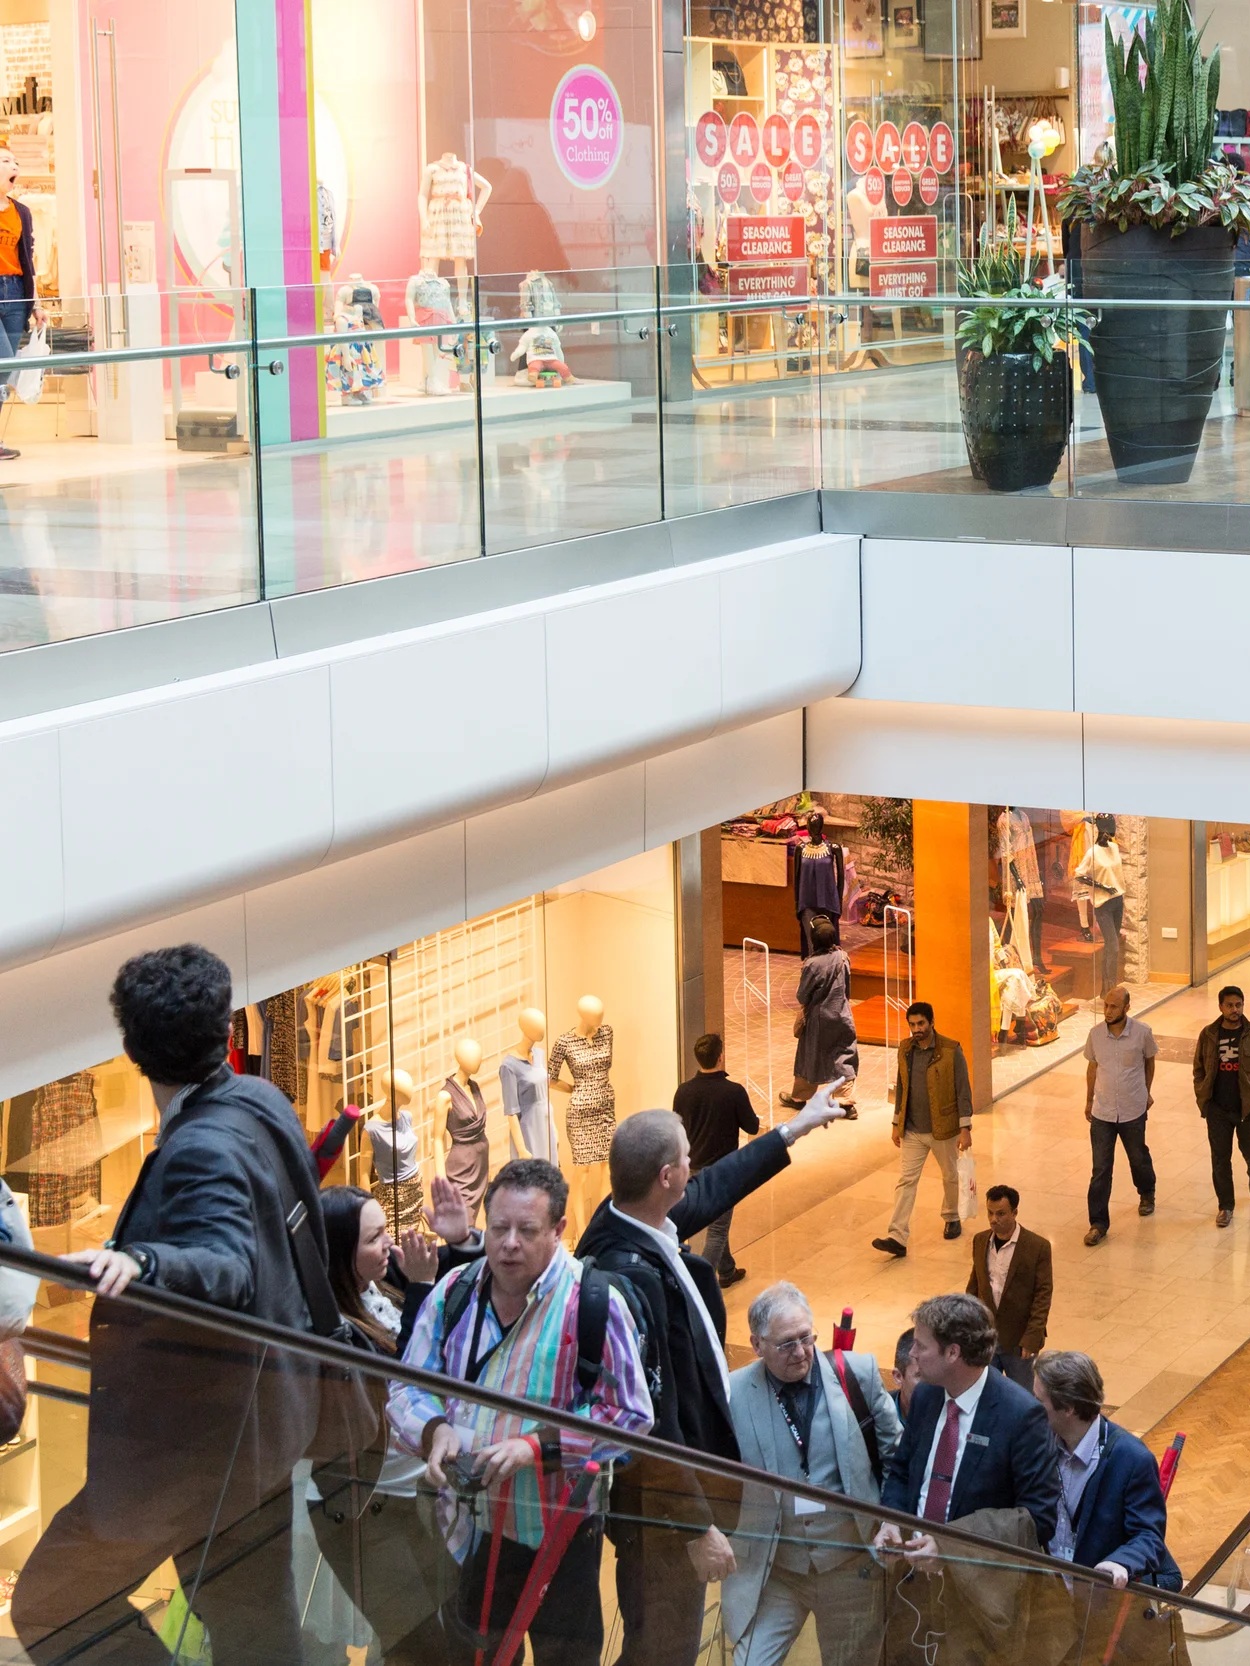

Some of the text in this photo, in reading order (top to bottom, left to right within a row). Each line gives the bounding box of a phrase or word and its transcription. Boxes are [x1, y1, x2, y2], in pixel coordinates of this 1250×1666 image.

[562, 97, 613, 140] 50%
[598, 123, 613, 139] off
[704, 122, 815, 156] SALE
[853, 131, 948, 163] SALE
[566, 145, 610, 165] Clothing
[742, 226, 791, 240] SEASONAL
[883, 226, 925, 239] SEASONAL
[741, 241, 793, 255] CLEARANCE
[882, 240, 926, 254] CLEARANCE
[738, 275, 796, 291] EVERYTHING
[878, 271, 927, 286] EVERYTHING
[885, 285, 924, 298] MUST GO!
